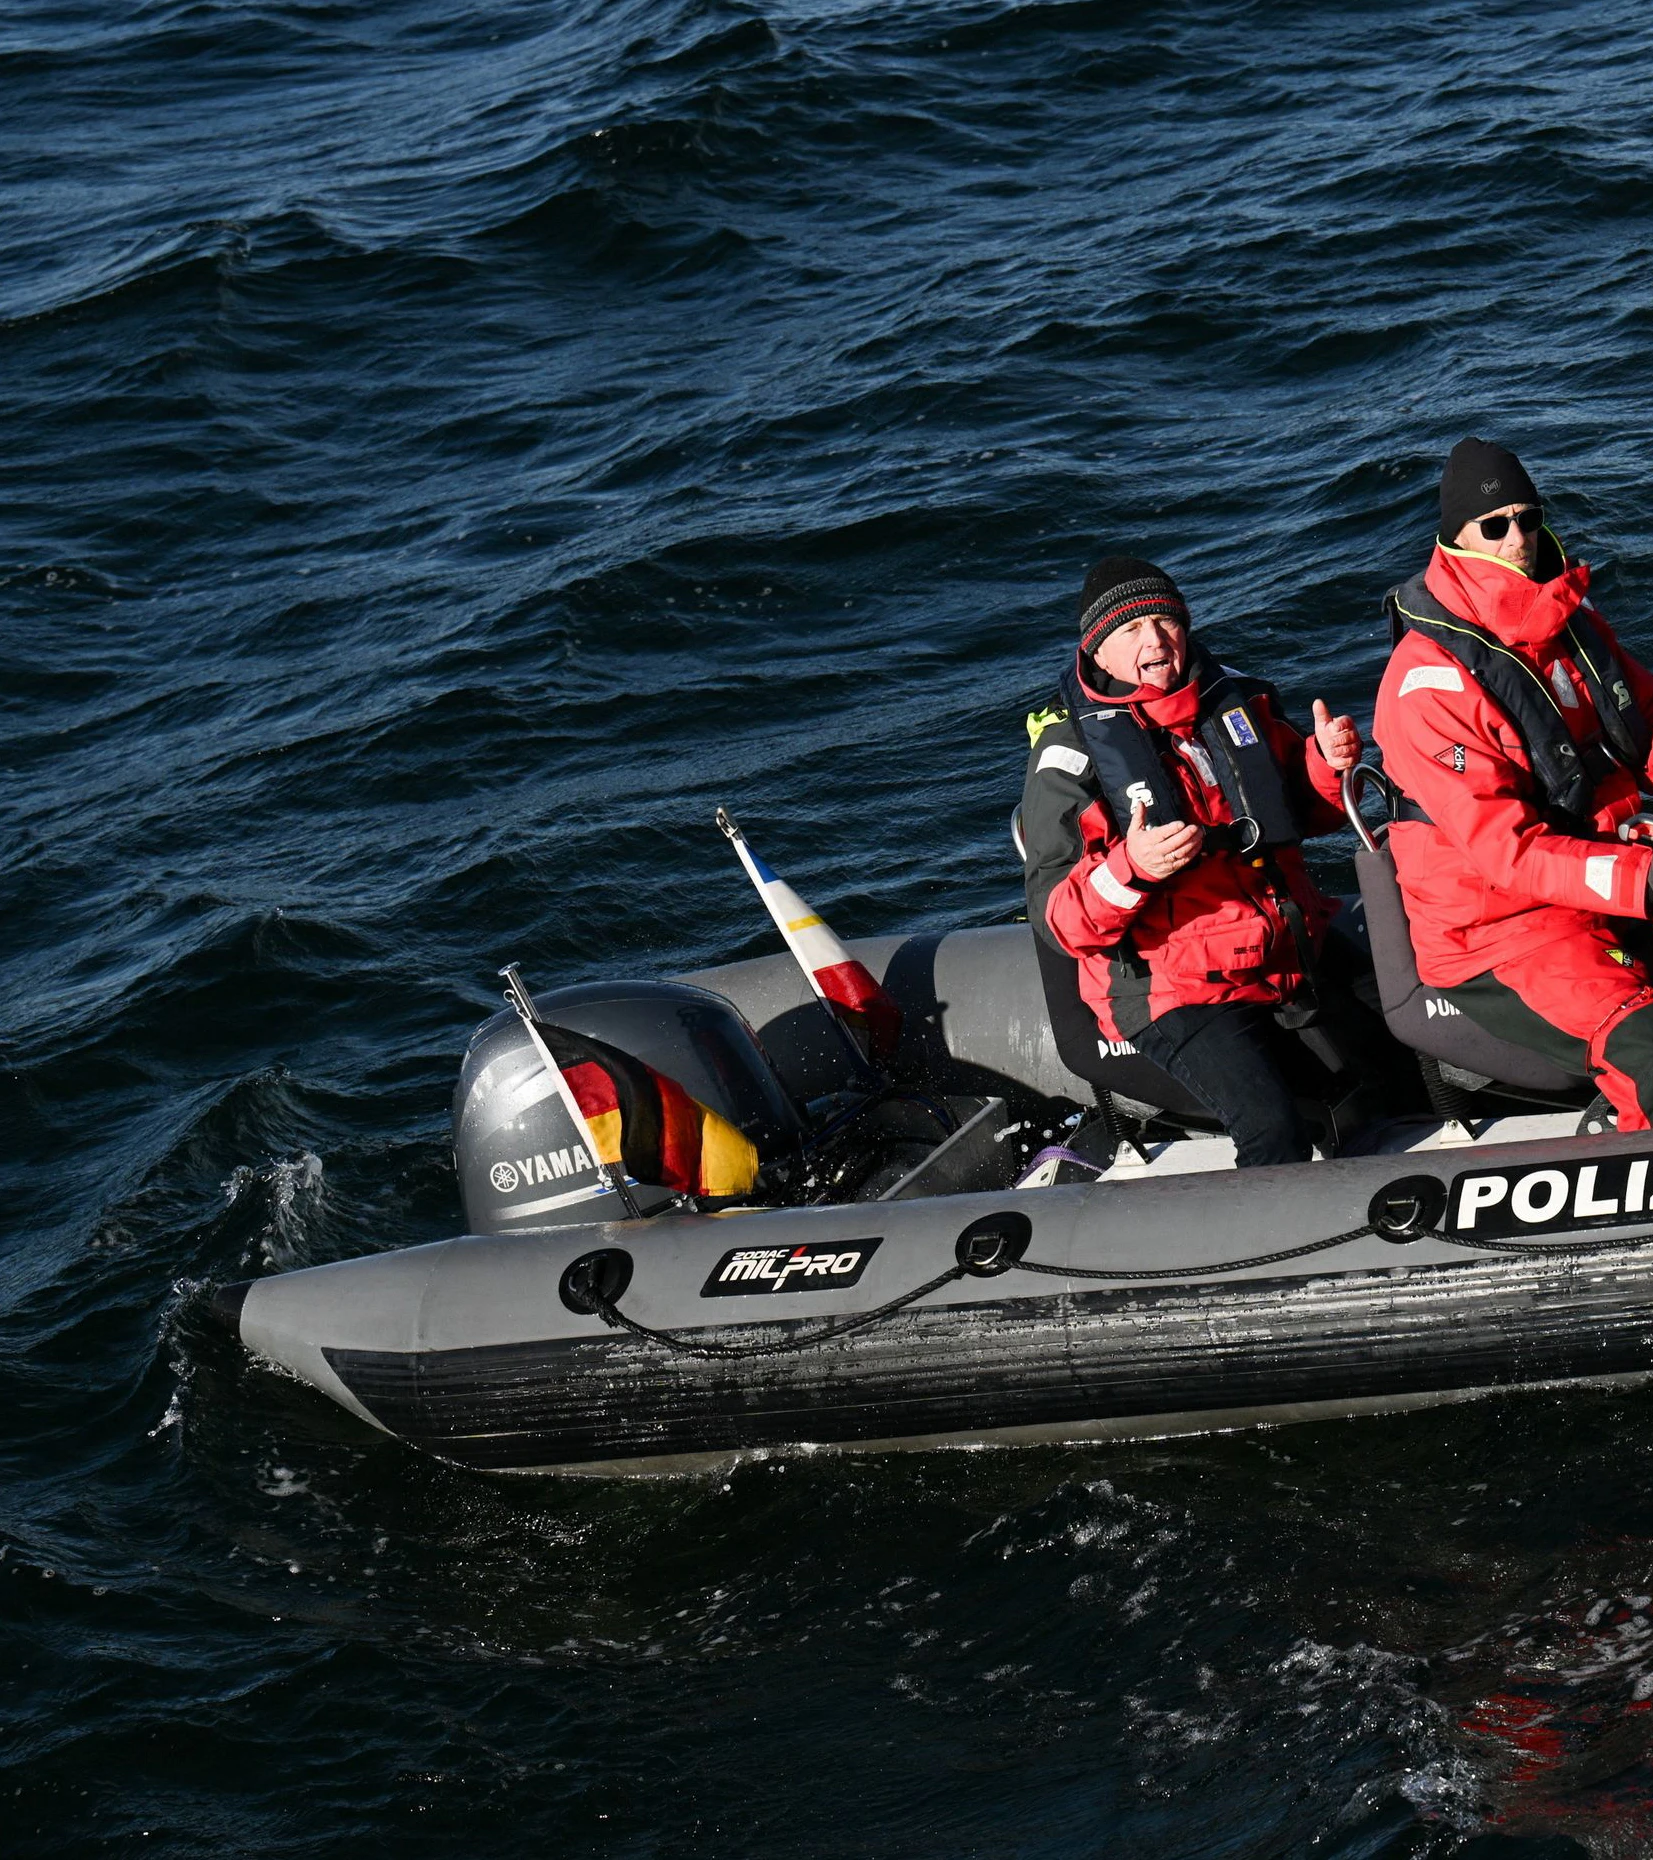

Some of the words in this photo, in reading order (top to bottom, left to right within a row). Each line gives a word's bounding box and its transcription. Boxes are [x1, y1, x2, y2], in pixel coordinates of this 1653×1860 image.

[1453, 744, 1465, 772] MPX
[516, 1144, 594, 1186] YAMA
[718, 1251, 861, 1291] MILPRO
[732, 1249, 790, 1260] ZODIAC
